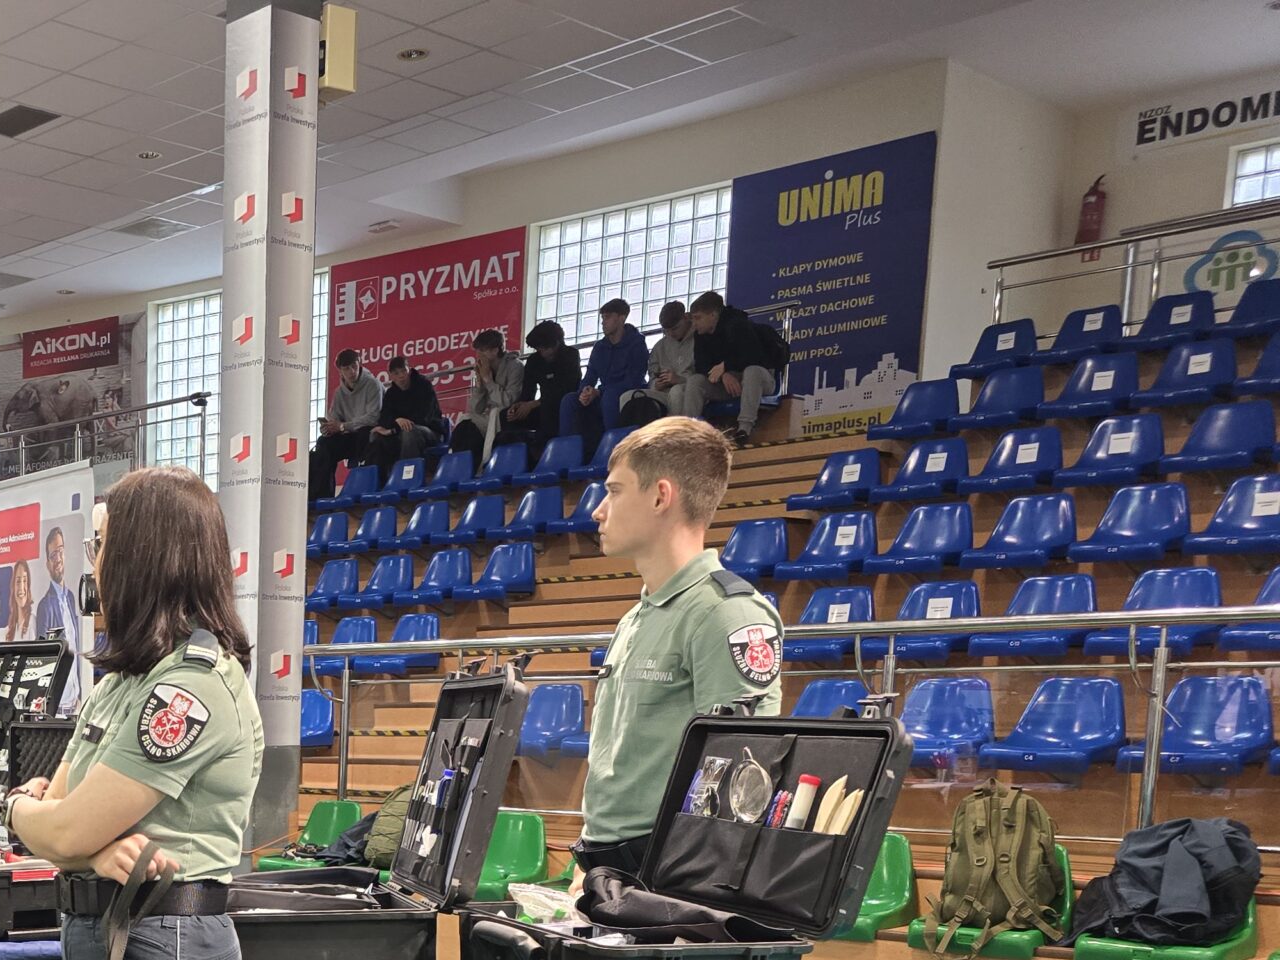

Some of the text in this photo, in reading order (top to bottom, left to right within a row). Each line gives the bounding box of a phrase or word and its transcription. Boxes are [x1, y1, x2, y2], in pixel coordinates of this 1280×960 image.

[1138, 105, 1172, 120] NZOZ
[845, 210, 881, 230] Plus
[240, 236, 265, 248] Inwestycji
[287, 240, 312, 252] Inwestycji
[778, 252, 864, 277] KLAPY DYMOWE
[381, 251, 520, 304] PRYZMAT
[777, 273, 871, 299] PASMA ŚWIETLNE
[473, 288, 497, 300] Spółka
[820, 295, 875, 314] DACHOWE
[816, 315, 888, 336] ALUMINIOWE
[53, 354, 79, 364] REKLAMA
[238, 358, 263, 369] Inwestycji
[284, 360, 309, 373] Inwestycji
[236, 477, 260, 487] Inwestycji
[282, 479, 306, 488] Inwestycji
[279, 594, 304, 602] Inwestycji
[140, 698, 202, 757] SŁUŻBA CELNO-SKARBOWA
